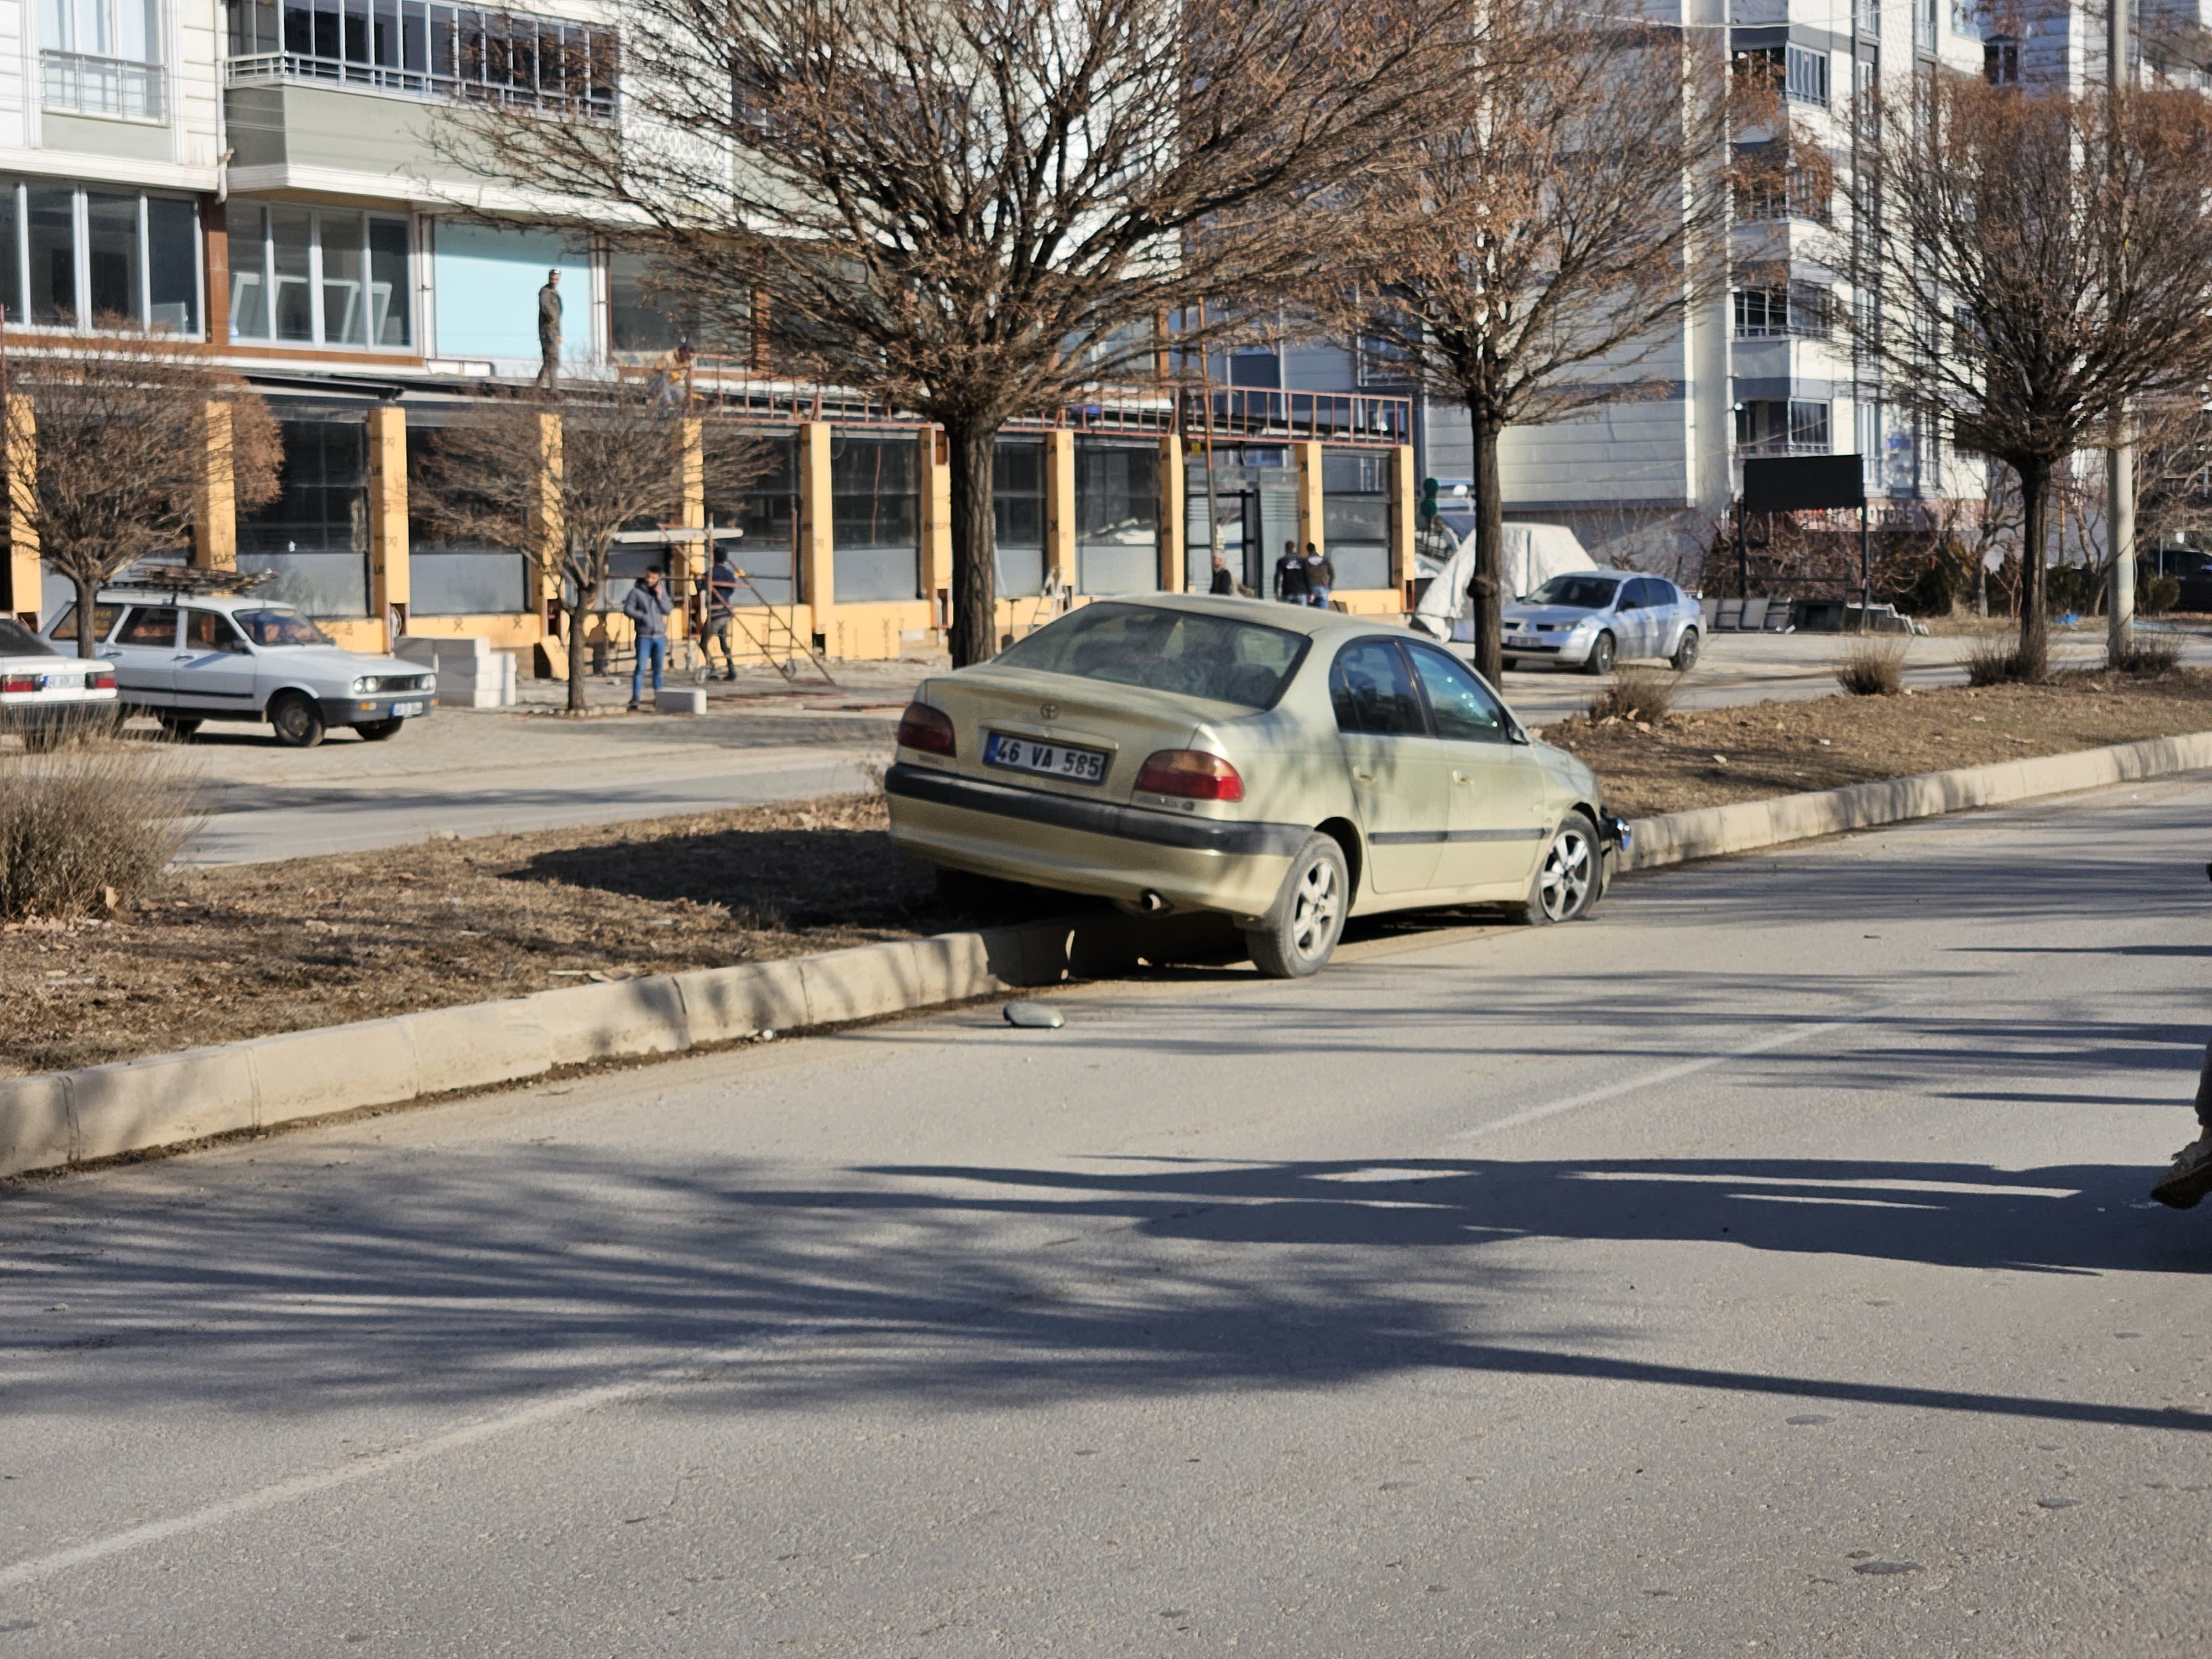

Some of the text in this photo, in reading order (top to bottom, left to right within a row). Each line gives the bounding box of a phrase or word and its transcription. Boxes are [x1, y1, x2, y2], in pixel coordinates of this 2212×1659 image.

[997, 740, 1100, 778] 46 VA 585
